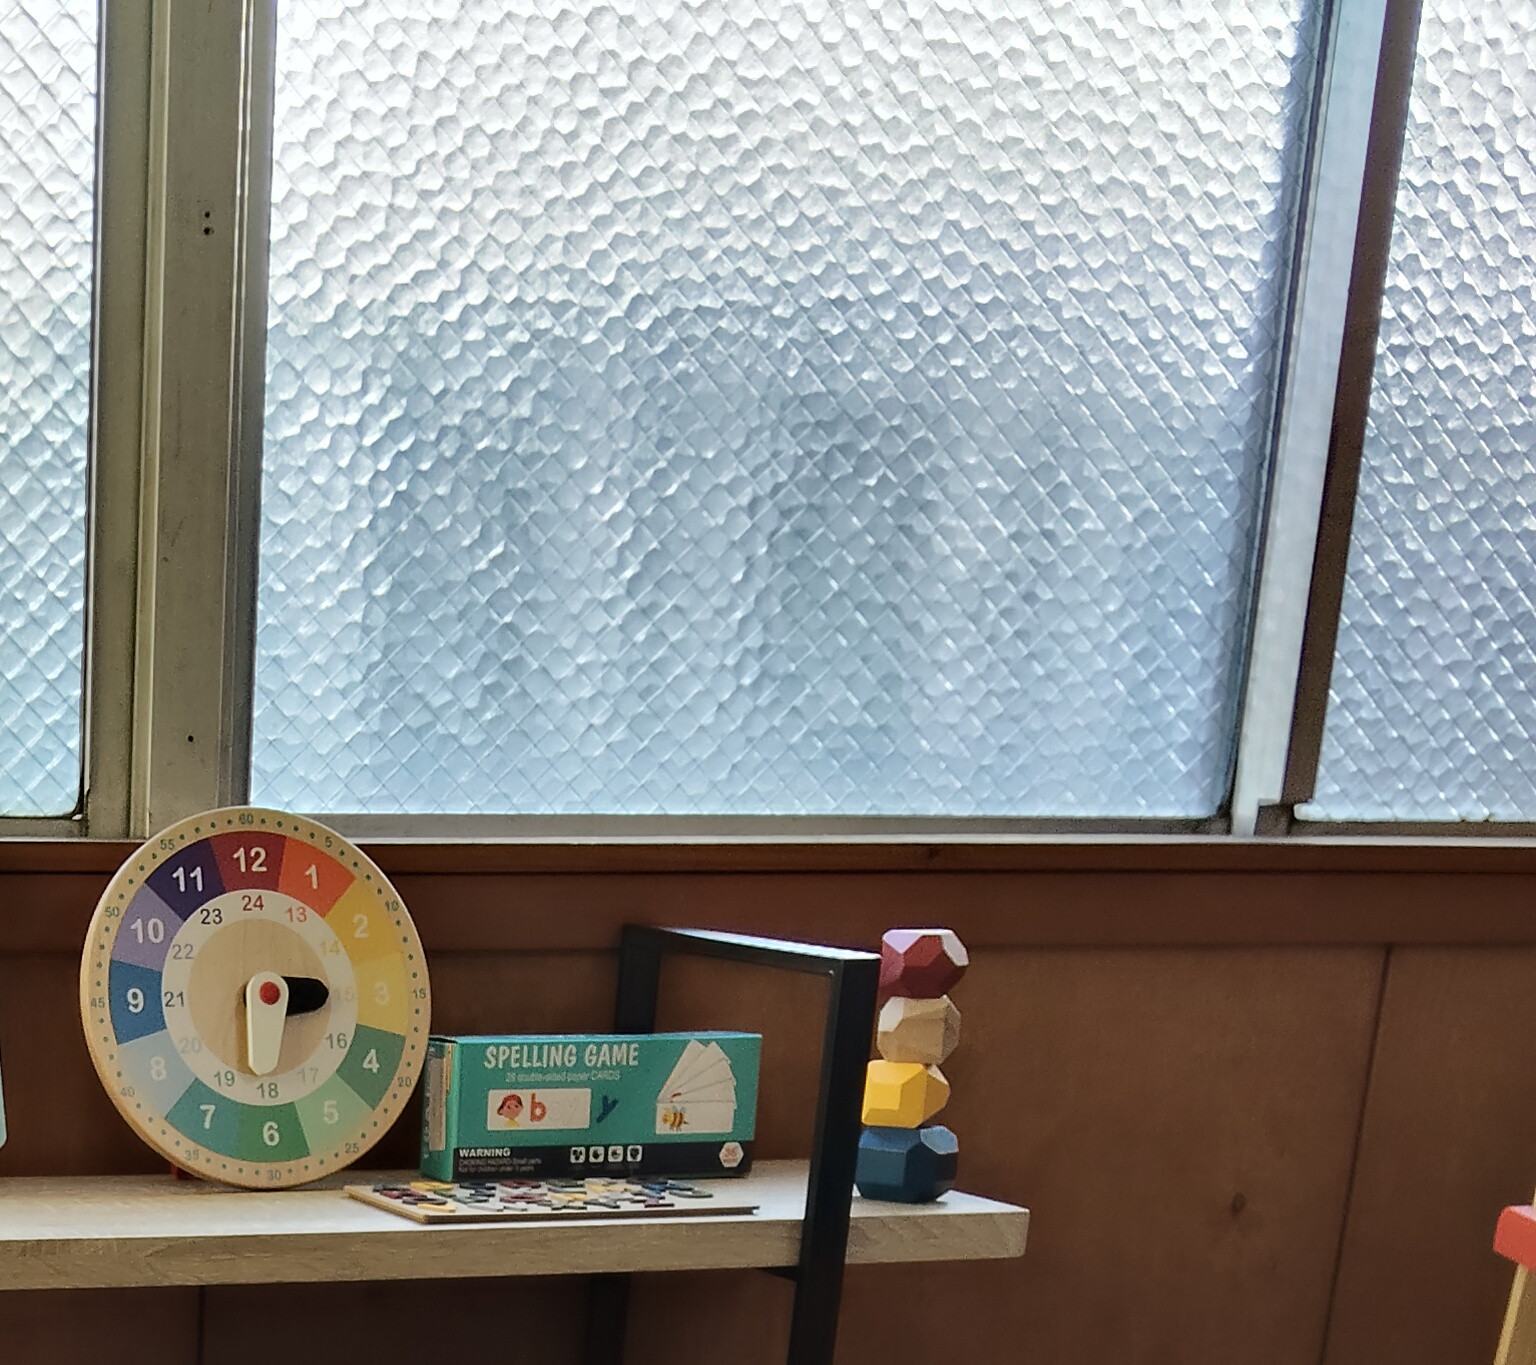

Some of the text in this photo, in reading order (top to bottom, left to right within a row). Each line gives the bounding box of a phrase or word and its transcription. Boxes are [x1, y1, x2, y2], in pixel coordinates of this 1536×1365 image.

[239, 813, 254, 826] 60
[160, 838, 176, 851] 55
[325, 837, 333, 848] 5
[232, 848, 268, 873] 12
[172, 867, 205, 892] 11
[304, 864, 320, 890] 1
[242, 895, 264, 912] 24
[385, 900, 400, 912] 10
[104, 907, 121, 919] 50
[200, 908, 224, 925] 23
[285, 906, 308, 923] 13
[131, 918, 164, 945] 10
[352, 914, 369, 938] 2
[172, 944, 195, 960] 22
[321, 940, 342, 956] 14
[127, 988, 145, 1013] 9
[164, 991, 185, 1008] 21
[374, 982, 390, 1005] 3
[178, 1038, 202, 1054] 20
[326, 1033, 348, 1050] 16
[363, 1048, 380, 1073] 4
[484, 1043, 639, 1069] SPELLING GAME
[150, 1056, 167, 1081] 8
[296, 1067, 320, 1084] 17
[213, 1070, 236, 1087] 19
[397, 1076, 412, 1088] 20
[256, 1082, 279, 1099] 18
[200, 1103, 217, 1129] 7
[322, 1099, 339, 1124] 5
[263, 1121, 281, 1147] 6
[344, 1142, 360, 1154] 25
[459, 1148, 511, 1157] WARNING
[266, 1169, 282, 1181] 30
